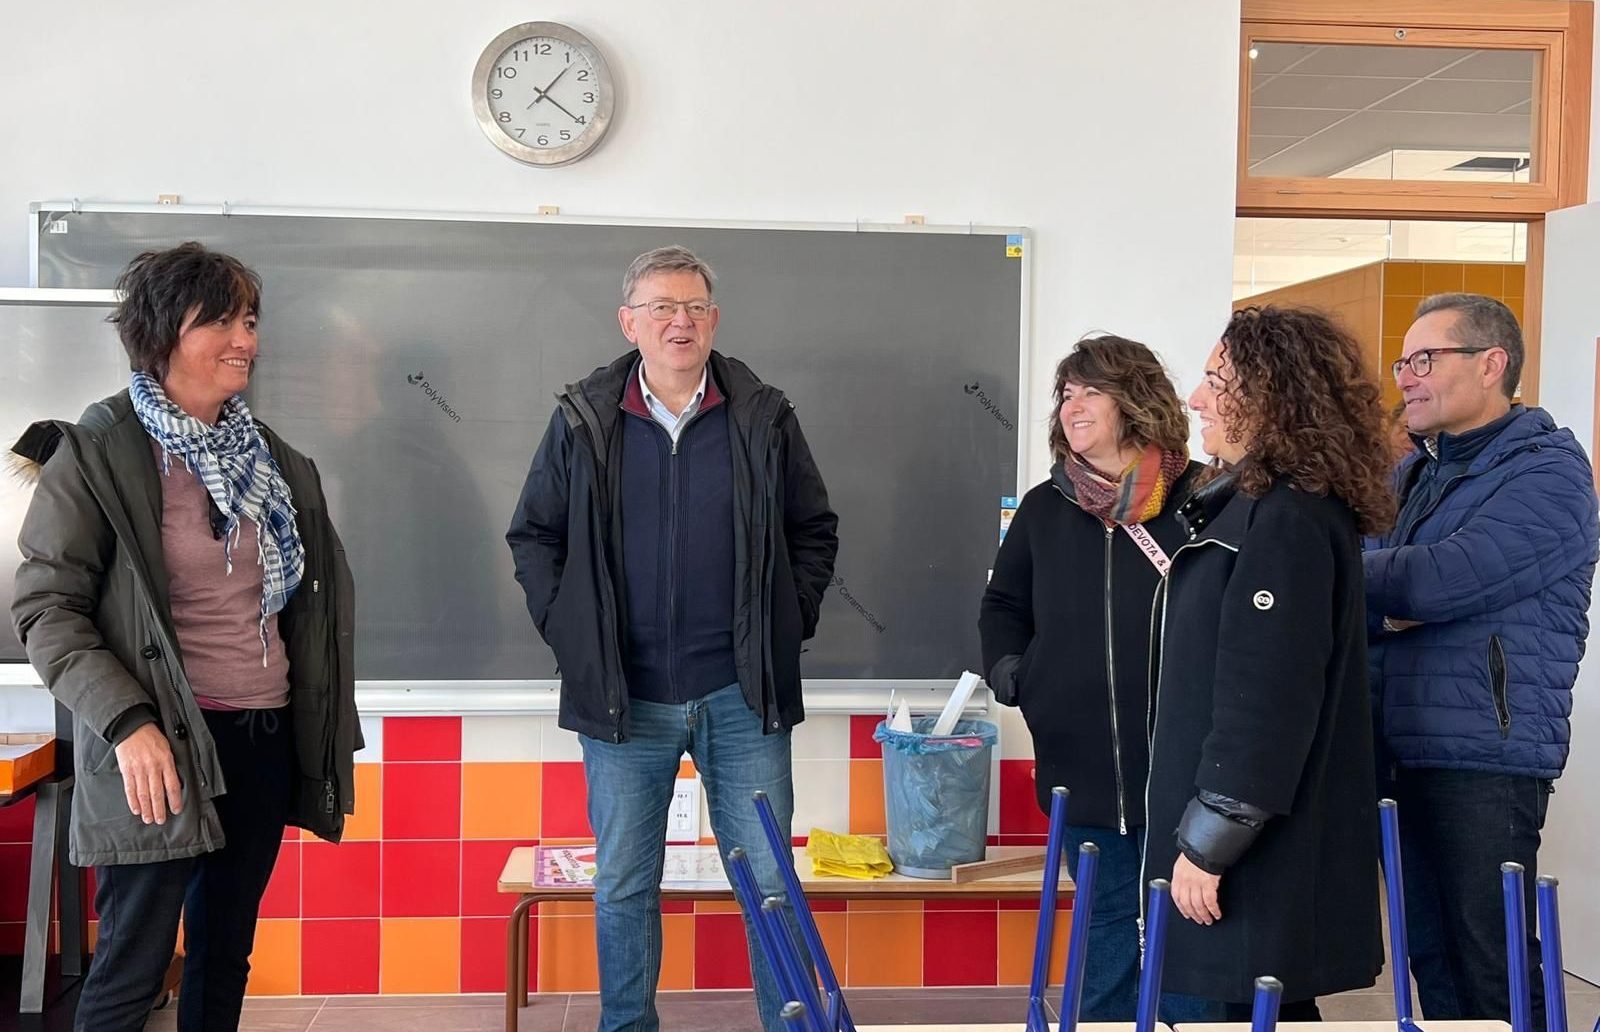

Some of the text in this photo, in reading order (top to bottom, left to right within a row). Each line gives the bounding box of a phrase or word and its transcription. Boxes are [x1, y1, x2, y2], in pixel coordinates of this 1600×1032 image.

[533, 43, 552, 55] 12
[513, 50, 528, 62] 11
[565, 52, 570, 63] 1
[497, 67, 517, 79] 10
[577, 70, 589, 81] 2
[491, 89, 503, 99] 9
[583, 92, 594, 103] 3
[499, 112, 512, 123] 8
[575, 115, 586, 125] 4
[515, 128, 526, 138] 7
[560, 130, 571, 140] 5
[537, 135, 548, 146] 6
[420, 381, 461, 423] PolyVision
[976, 391, 1014, 431] PolyVision
[1128, 523, 1167, 567] DEVOTA &
